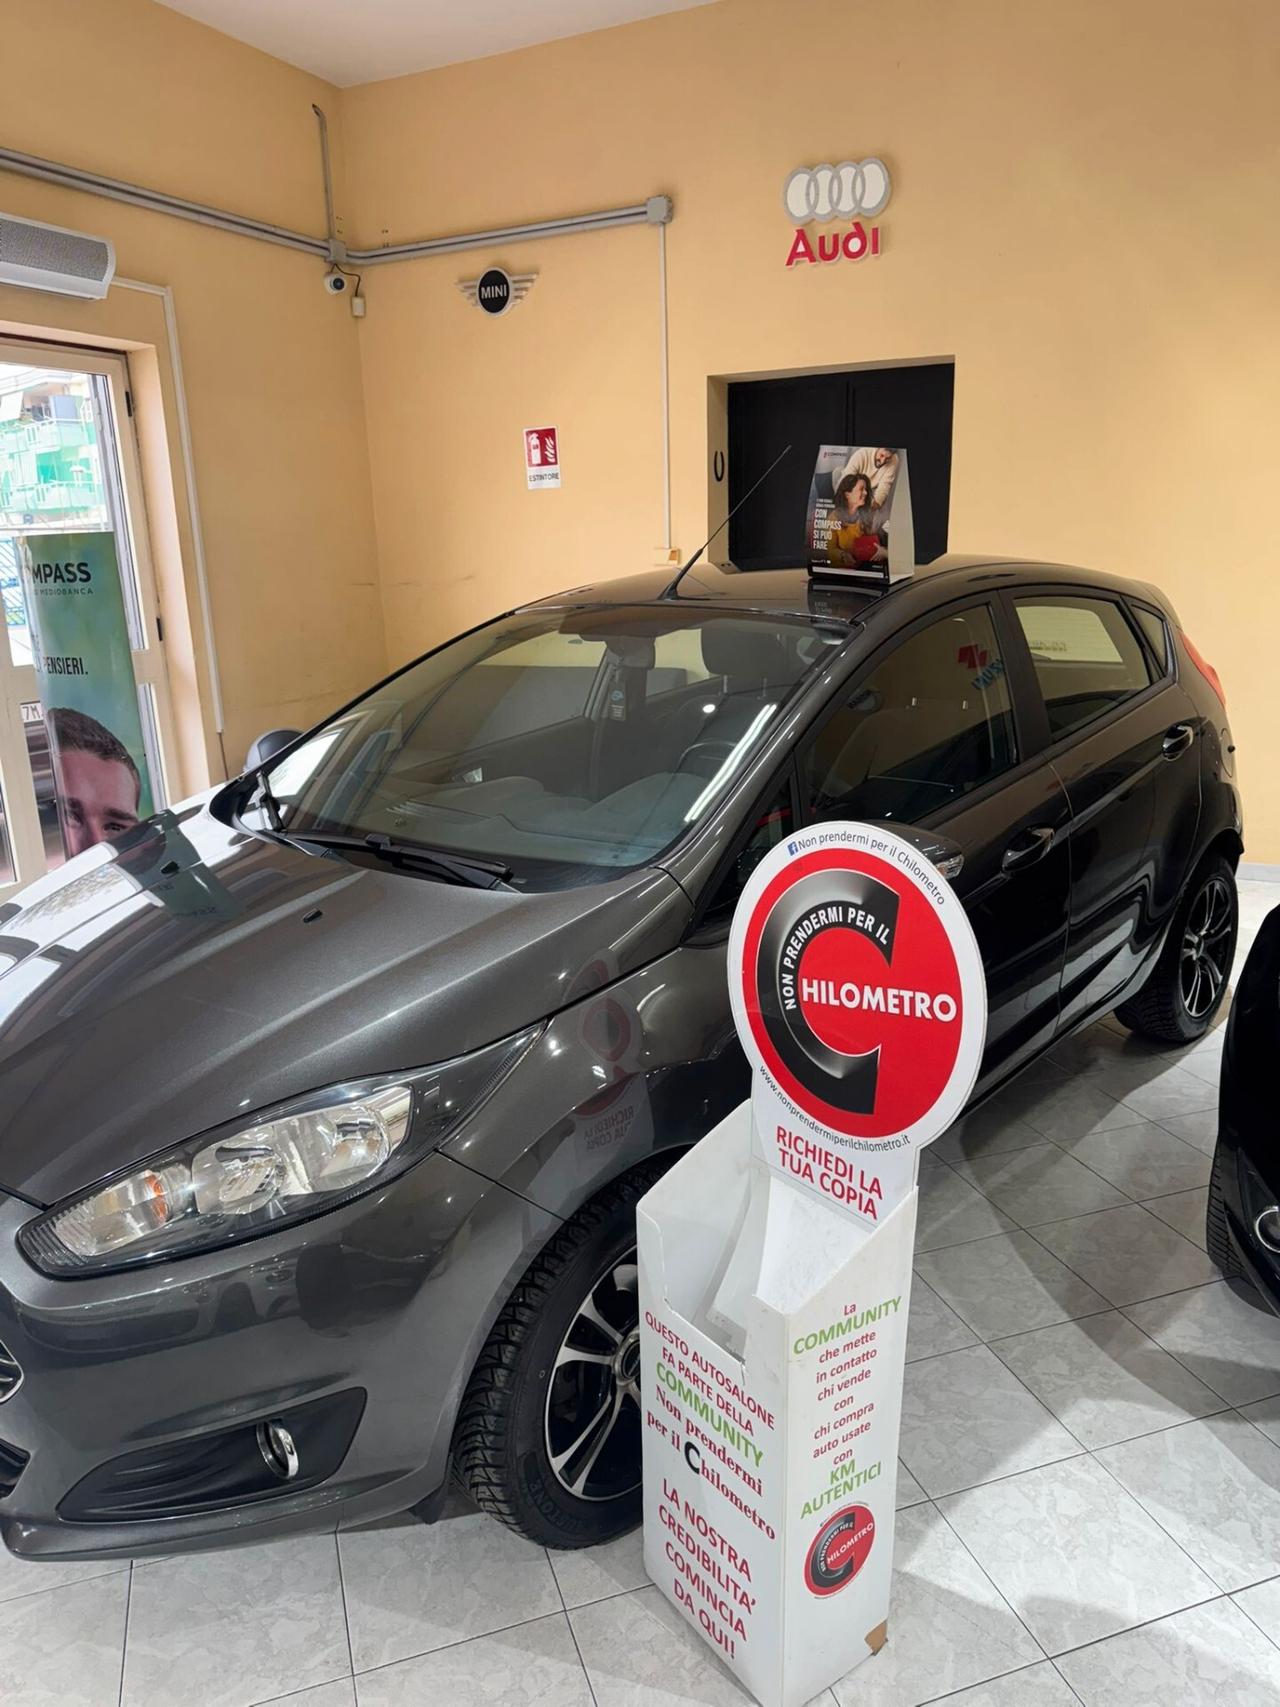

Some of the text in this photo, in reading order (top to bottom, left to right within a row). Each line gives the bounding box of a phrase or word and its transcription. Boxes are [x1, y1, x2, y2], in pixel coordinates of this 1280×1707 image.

[785, 221, 879, 267] Audi
[480, 284, 507, 299] MINI
[528, 472, 560, 482] ESTINTORE
[813, 519, 842, 530] COMPASS
[815, 509, 827, 518] CON
[813, 540, 827, 550] FARE
[31, 562, 91, 583] MPASS
[798, 831, 945, 906] Non prendermi per il Chilometro
[782, 905, 889, 1011] NON PRENDERMI PER IL
[760, 1065, 911, 1152] www.nonprendermiperilchilometro.it
[776, 1125, 883, 1200] RICHIEDI LA
[779, 1147, 878, 1220] TUA COPIA
[793, 1296, 901, 1355] COMMUNITY
[843, 1304, 856, 1316] La
[645, 1311, 775, 1431] QUESTO AUTOSALONE
[816, 1349, 877, 1384] in contatto
[819, 1331, 876, 1363] che mette
[662, 1347, 754, 1436] FA PARTE DELLA
[817, 1368, 871, 1401] chi vende
[834, 1395, 854, 1412] con
[656, 1362, 763, 1468] COMMUNITY
[656, 1385, 763, 1497] Non prendermi
[813, 1421, 871, 1458] auto usate
[814, 1403, 874, 1439] chi compra
[647, 1410, 776, 1540] per il Chilometro
[830, 1459, 855, 1485] KM
[833, 1448, 853, 1465] con
[800, 1461, 881, 1519] AUTENTICI
[663, 1478, 752, 1583] LA NOSTRA
[659, 1504, 757, 1615] CREDIBILITA'
[666, 1541, 747, 1641] COMINCIA
[674, 1578, 736, 1660] DA QUI!
